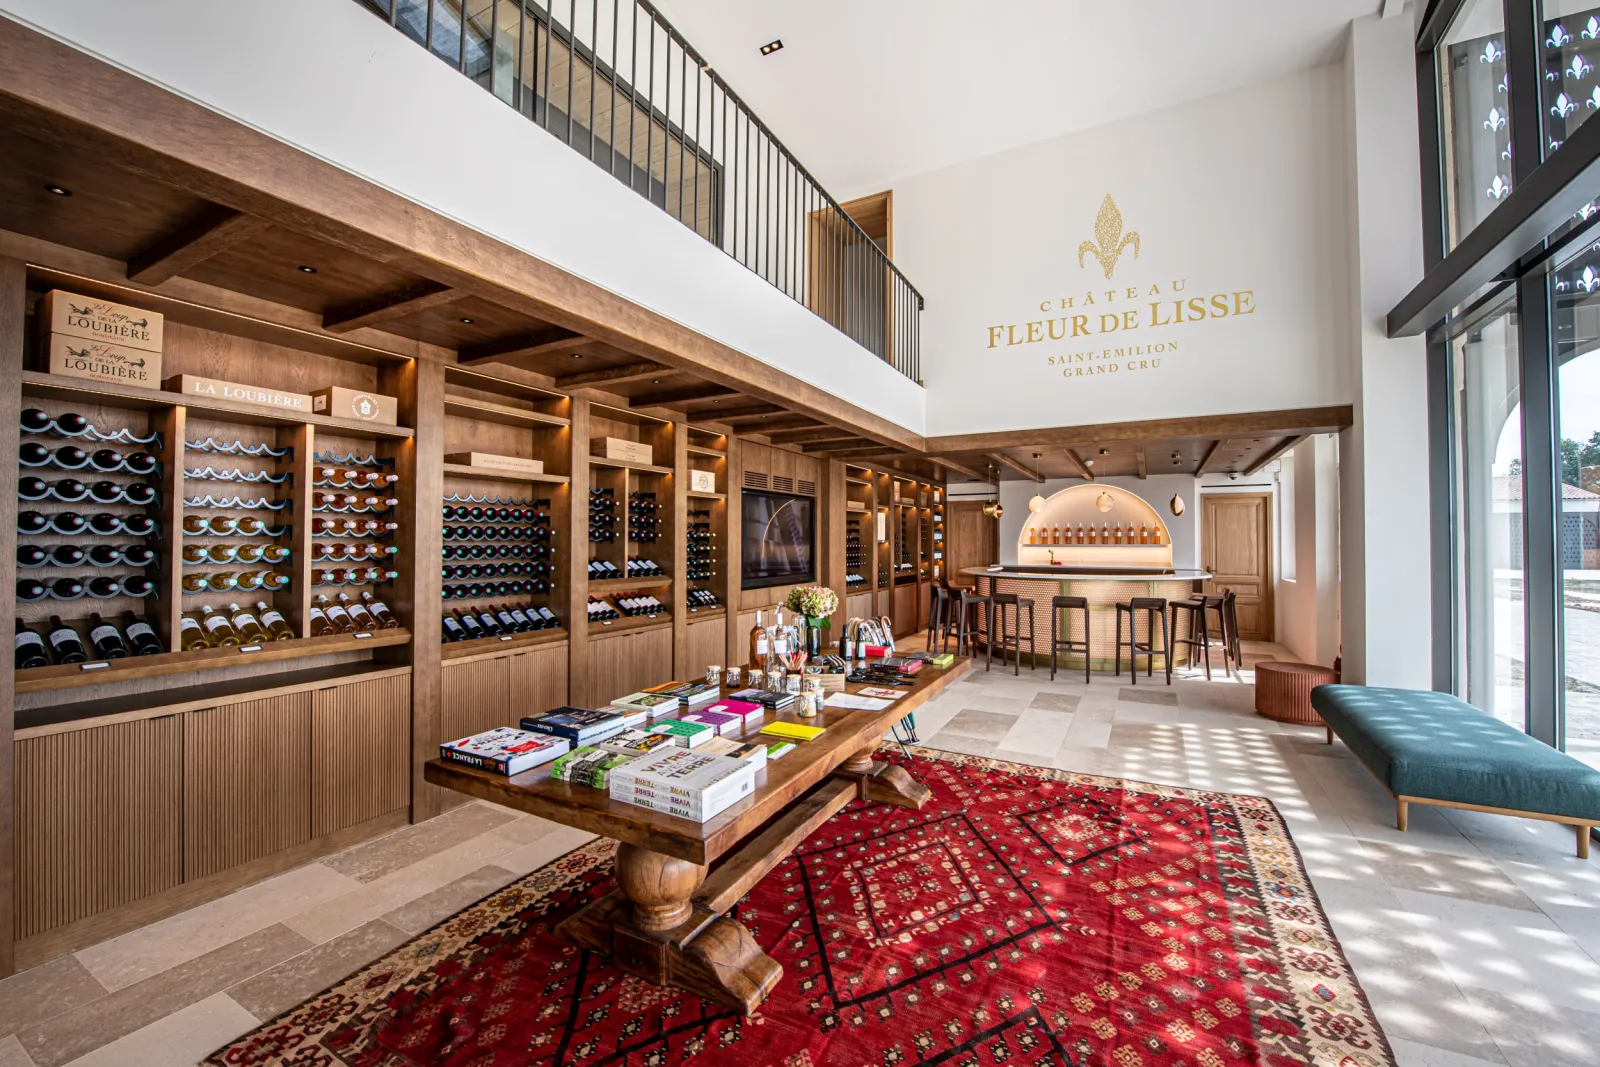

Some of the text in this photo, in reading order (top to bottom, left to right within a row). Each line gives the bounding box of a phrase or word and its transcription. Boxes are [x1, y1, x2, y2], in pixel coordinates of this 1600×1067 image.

[1039, 279, 1187, 313] CHÂTEAU
[100, 303, 129, 321] Loup
[986, 290, 1257, 349] FLEUR DE LISSE
[68, 316, 150, 341] LOUBIÈRE
[96, 345, 126, 363] Loup
[1047, 341, 1180, 366] SAINT-EMILION
[64, 358, 148, 381] LOUBIÈRE
[1063, 358, 1162, 378] GRAND CRU
[195, 382, 216, 394] LA
[223, 386, 302, 408] LOUBIÈRE
[452, 752, 482, 766] LA FRANCE
[641, 750, 692, 773] VIVRE
[665, 756, 716, 779] TERRE
[634, 777, 655, 788] TERRE
[633, 787, 655, 798] TERRE
[670, 787, 690, 798] VIVRE
[670, 796, 691, 807] VIVRE
[633, 797, 654, 808] TERRE
[669, 806, 690, 817] VIVRE
